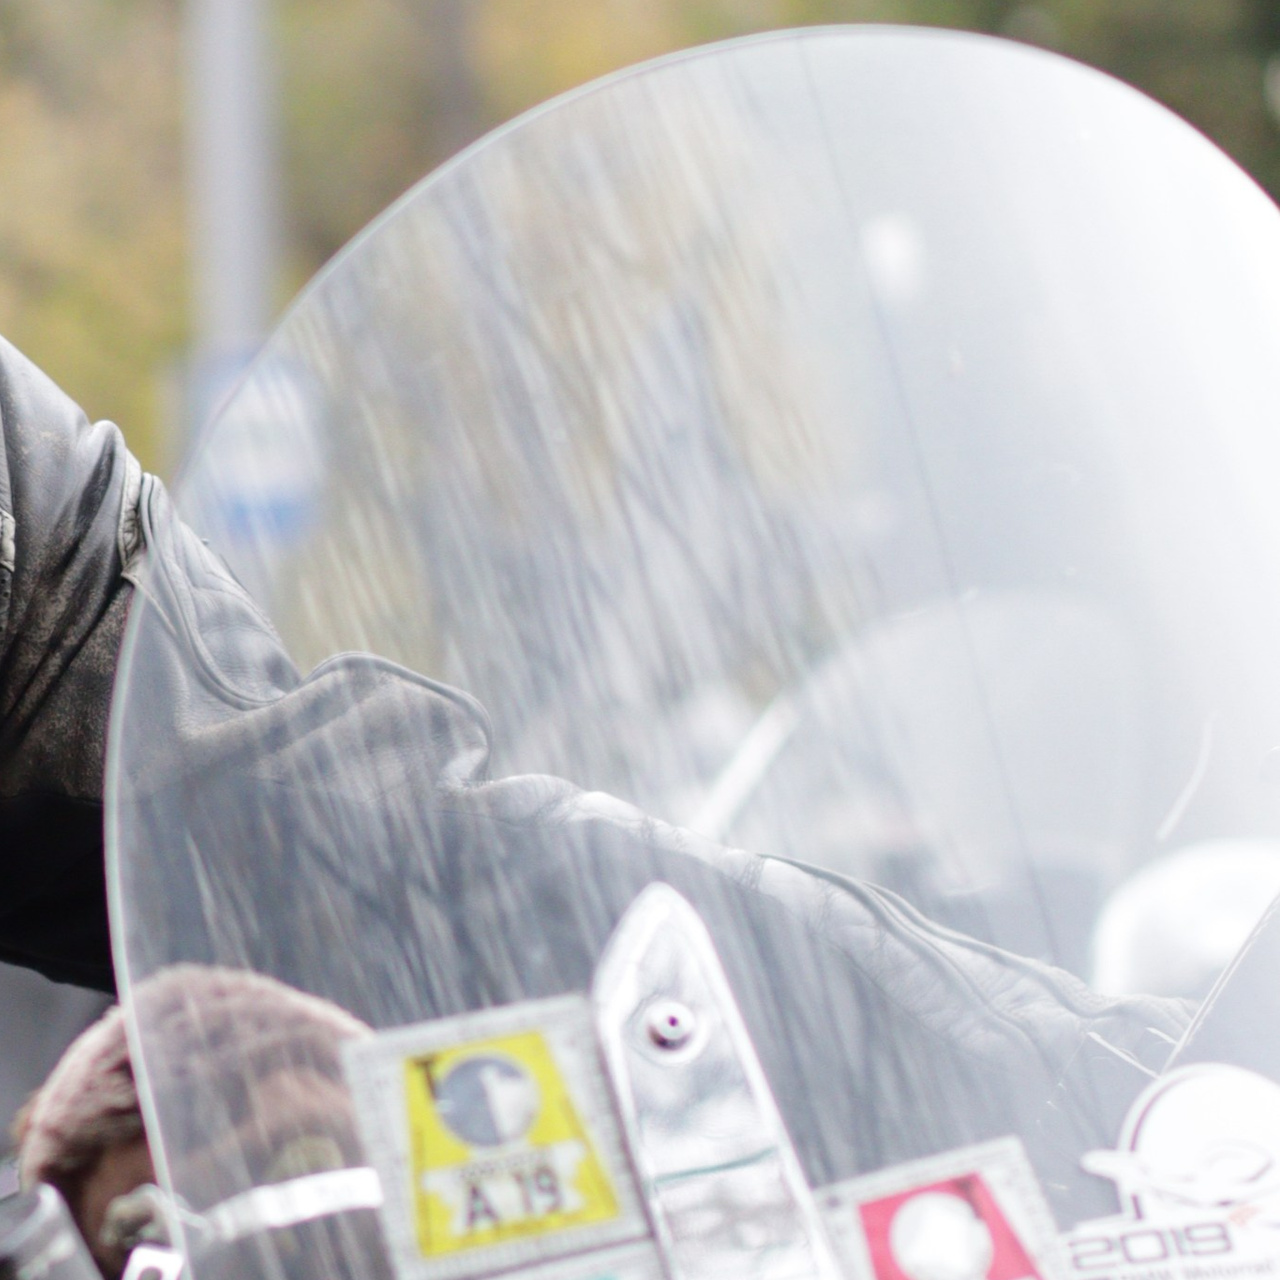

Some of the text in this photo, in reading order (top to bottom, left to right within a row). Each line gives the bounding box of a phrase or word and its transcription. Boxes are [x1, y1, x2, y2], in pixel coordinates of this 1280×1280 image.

[466, 1179, 500, 1235] A
[512, 1165, 564, 1215] 19
[1067, 1220, 1233, 1271] 2019
